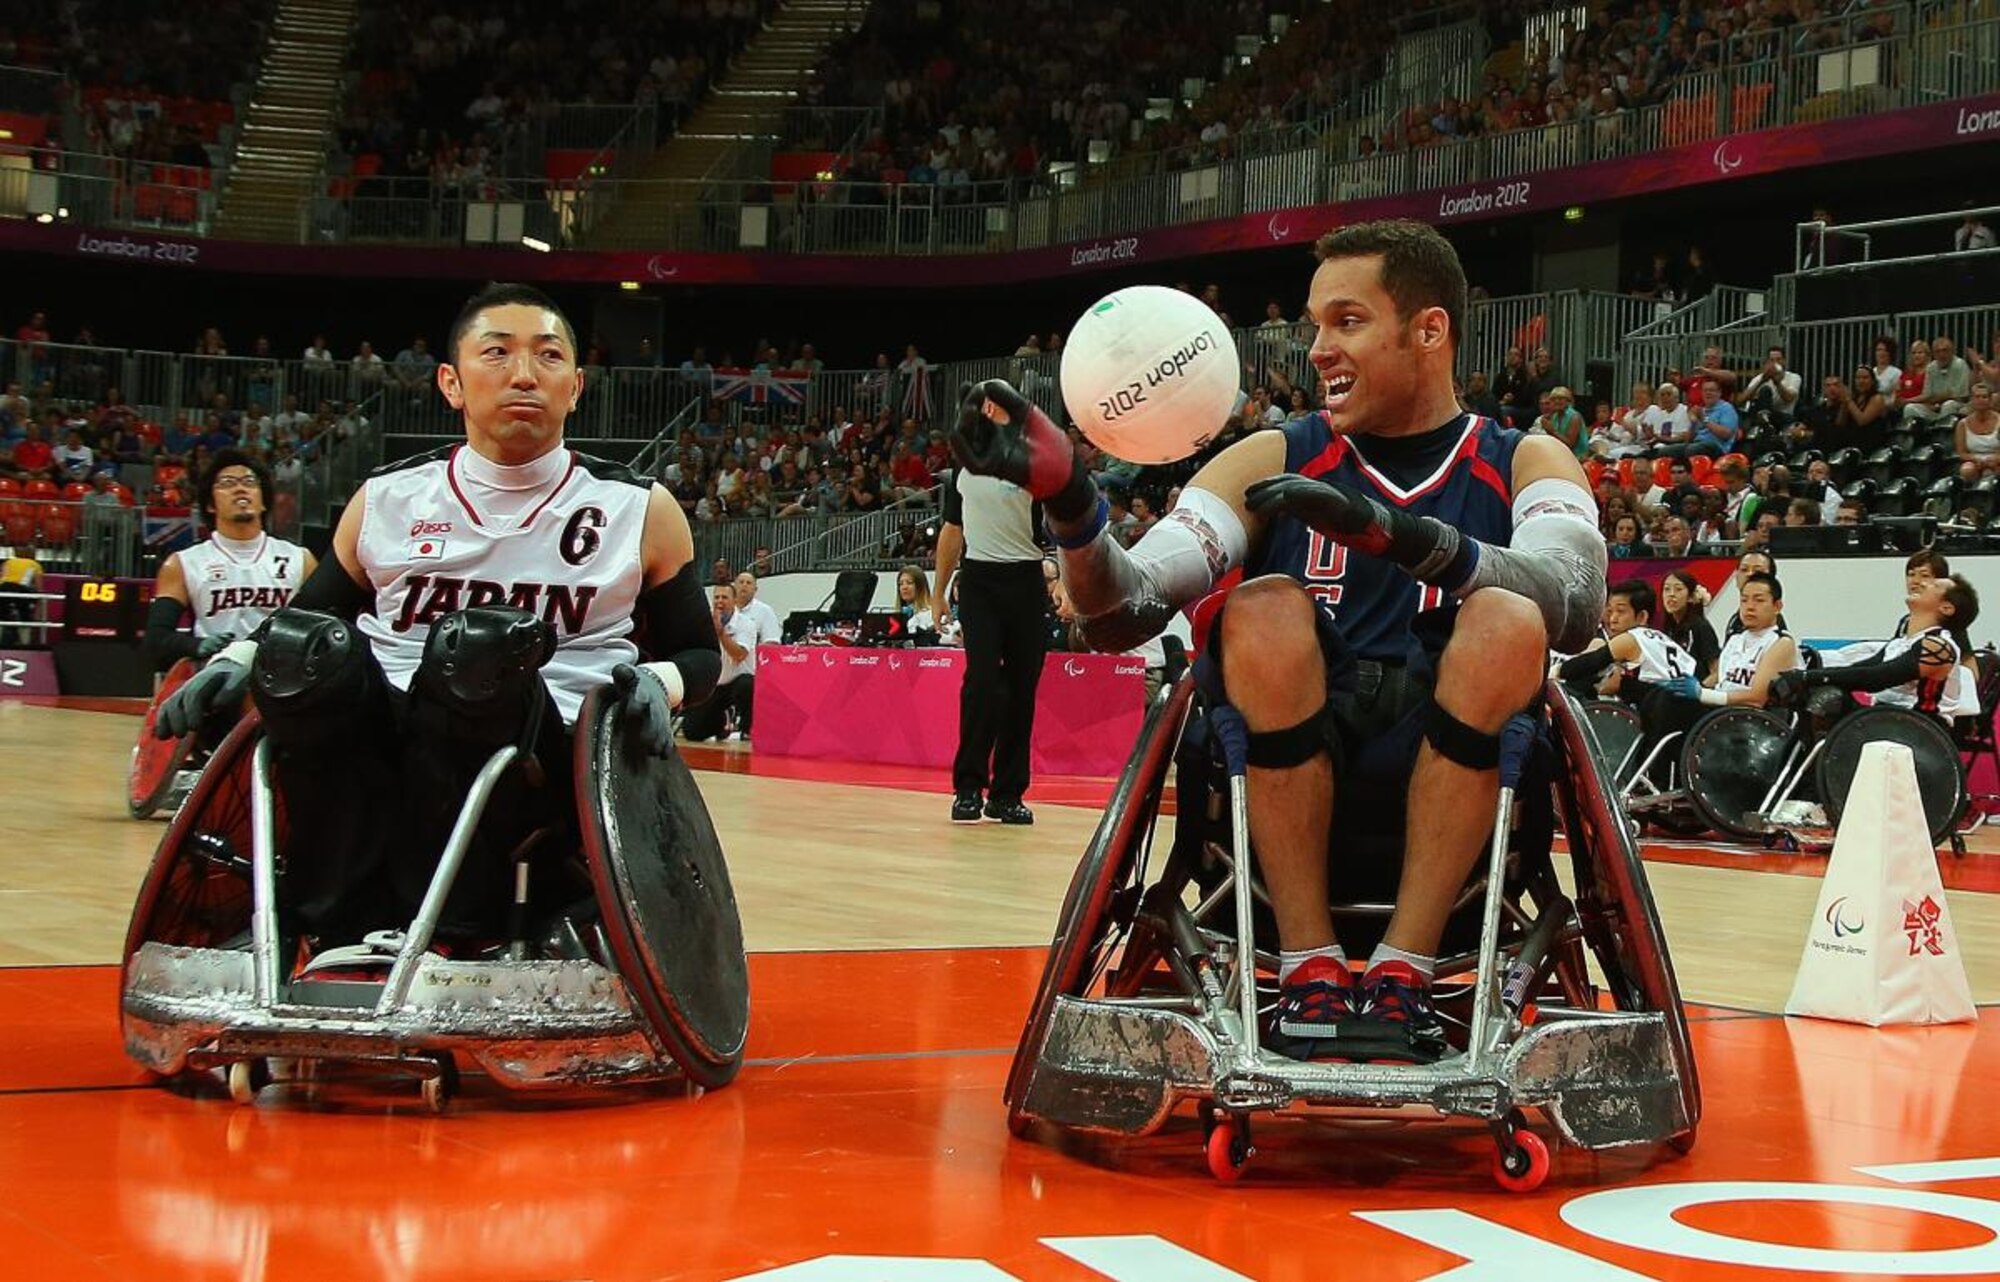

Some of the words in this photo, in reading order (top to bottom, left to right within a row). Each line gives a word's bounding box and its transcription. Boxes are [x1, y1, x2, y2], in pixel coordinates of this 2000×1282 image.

[1440, 188, 1492, 216] London
[1495, 182, 1530, 207] 2012
[79, 234, 150, 258] London
[154, 241, 199, 263] 2012
[1071, 242, 1111, 266] London
[1112, 238, 1138, 259] 2012
[1147, 331, 1217, 387] London
[1099, 382, 1147, 421] 2012
[411, 519, 452, 537] asics
[559, 506, 607, 566] 6
[274, 556, 290, 579] 7
[205, 586, 293, 617] JAPAN
[391, 576, 599, 636] JAPAN
[1114, 664, 1146, 676] London
[1666, 646, 1682, 679] 5
